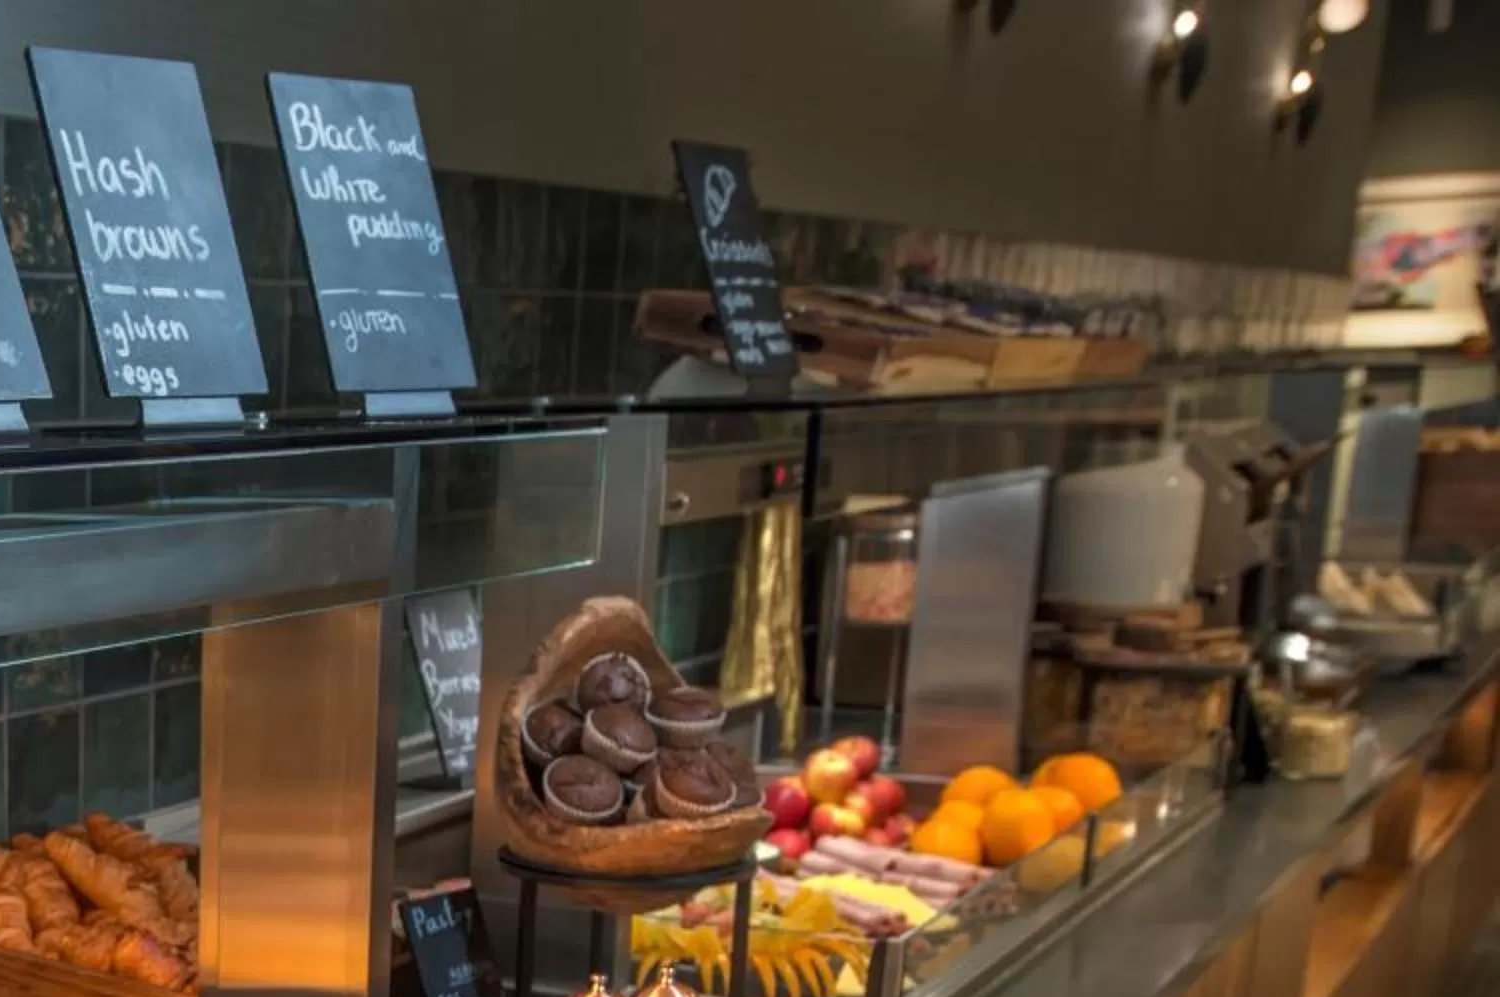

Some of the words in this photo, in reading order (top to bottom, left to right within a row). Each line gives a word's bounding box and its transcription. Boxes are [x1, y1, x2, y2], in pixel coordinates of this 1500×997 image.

[289, 101, 381, 153] Black
[60, 128, 170, 199] Hash
[300, 164, 387, 203] White
[85, 208, 211, 262] browns
[348, 213, 444, 256] pudding
[123, 364, 179, 397] eggs
